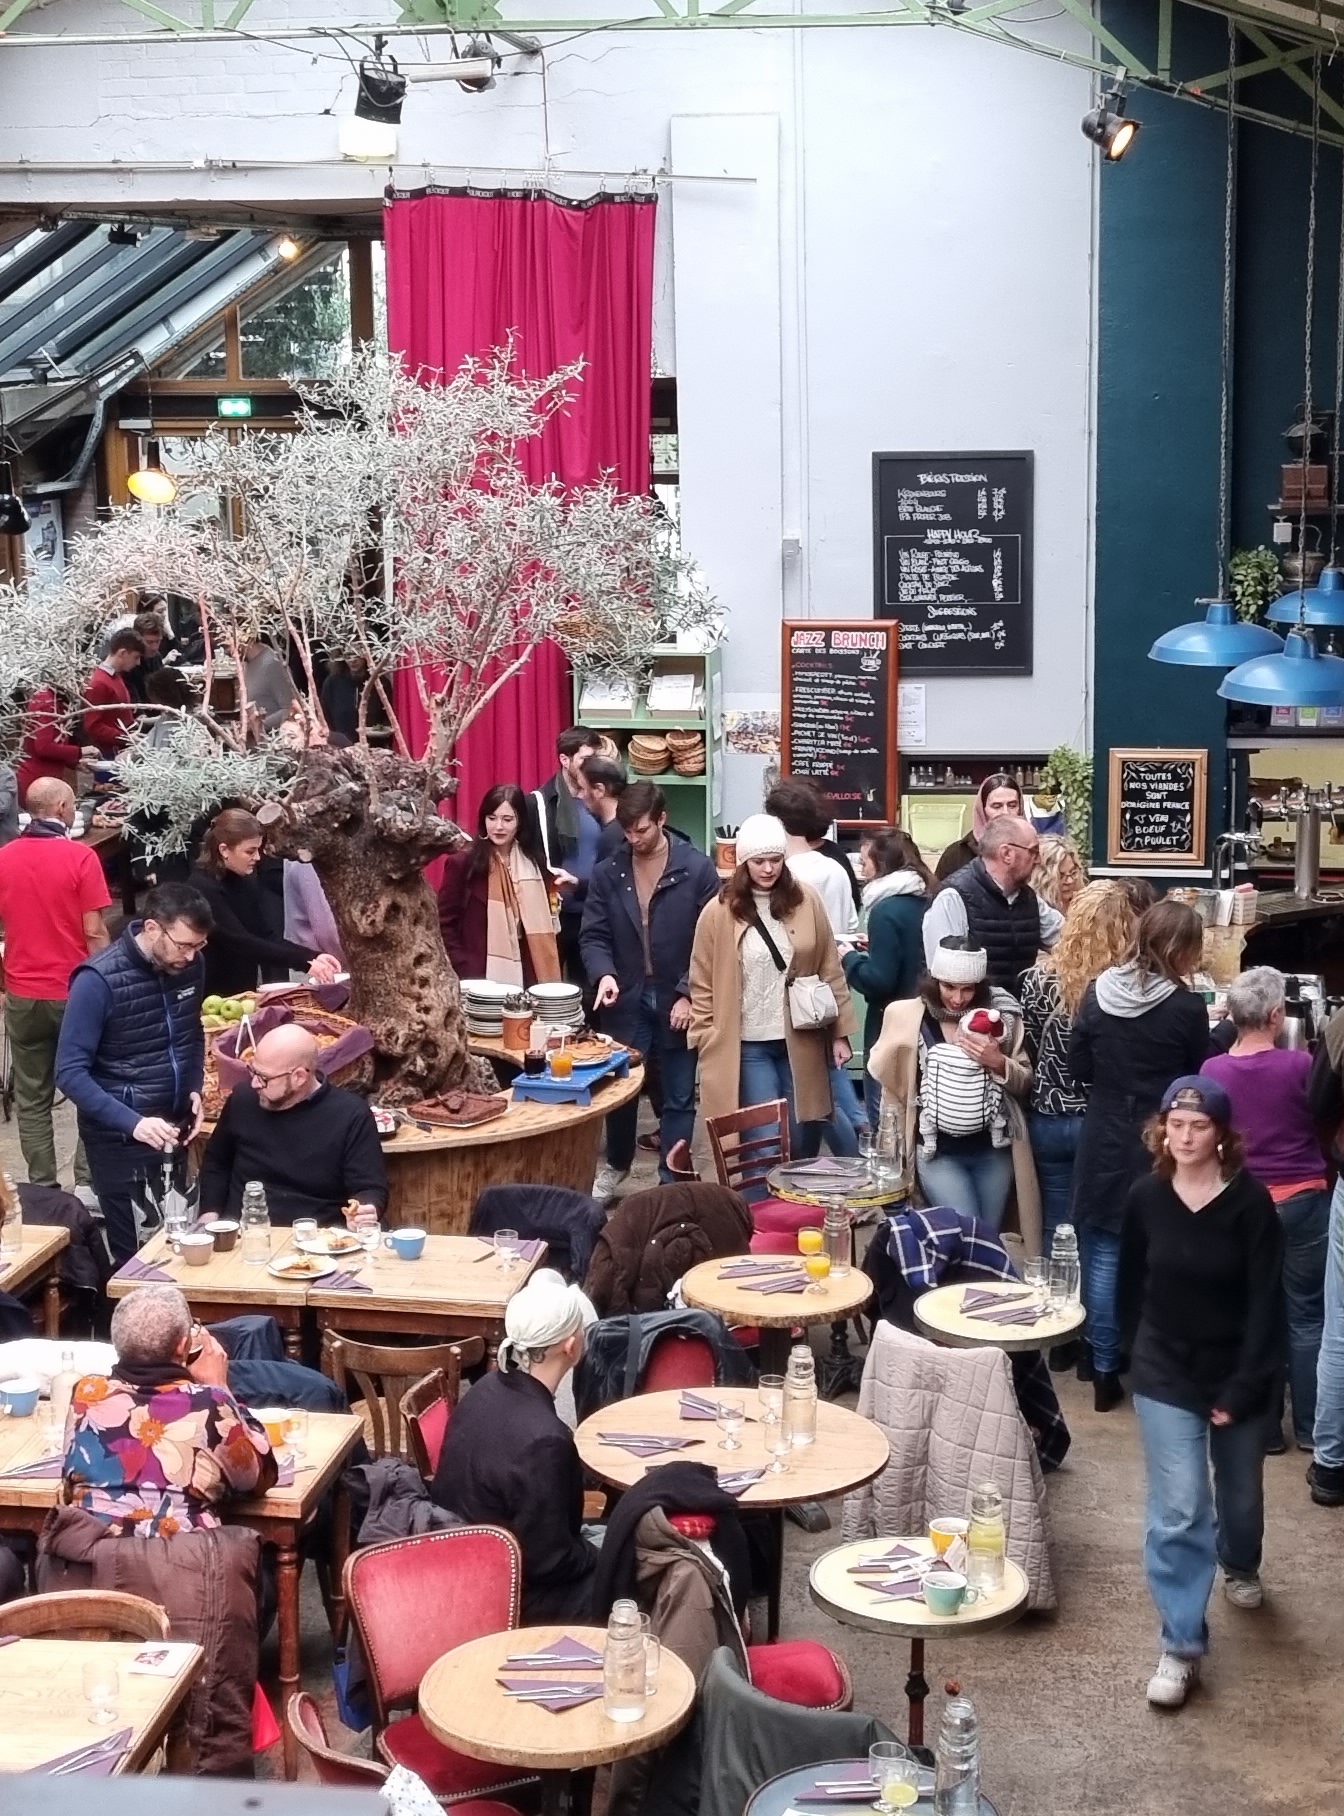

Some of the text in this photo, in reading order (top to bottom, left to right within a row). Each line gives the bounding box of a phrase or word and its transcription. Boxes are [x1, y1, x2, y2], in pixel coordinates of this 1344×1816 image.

[791, 631, 887, 650] JAZZ BRUNCH
[1129, 782, 1185, 791] NOS VIANDES
[1145, 791, 1168, 799] SONT
[1144, 836, 1180, 845] POULET
